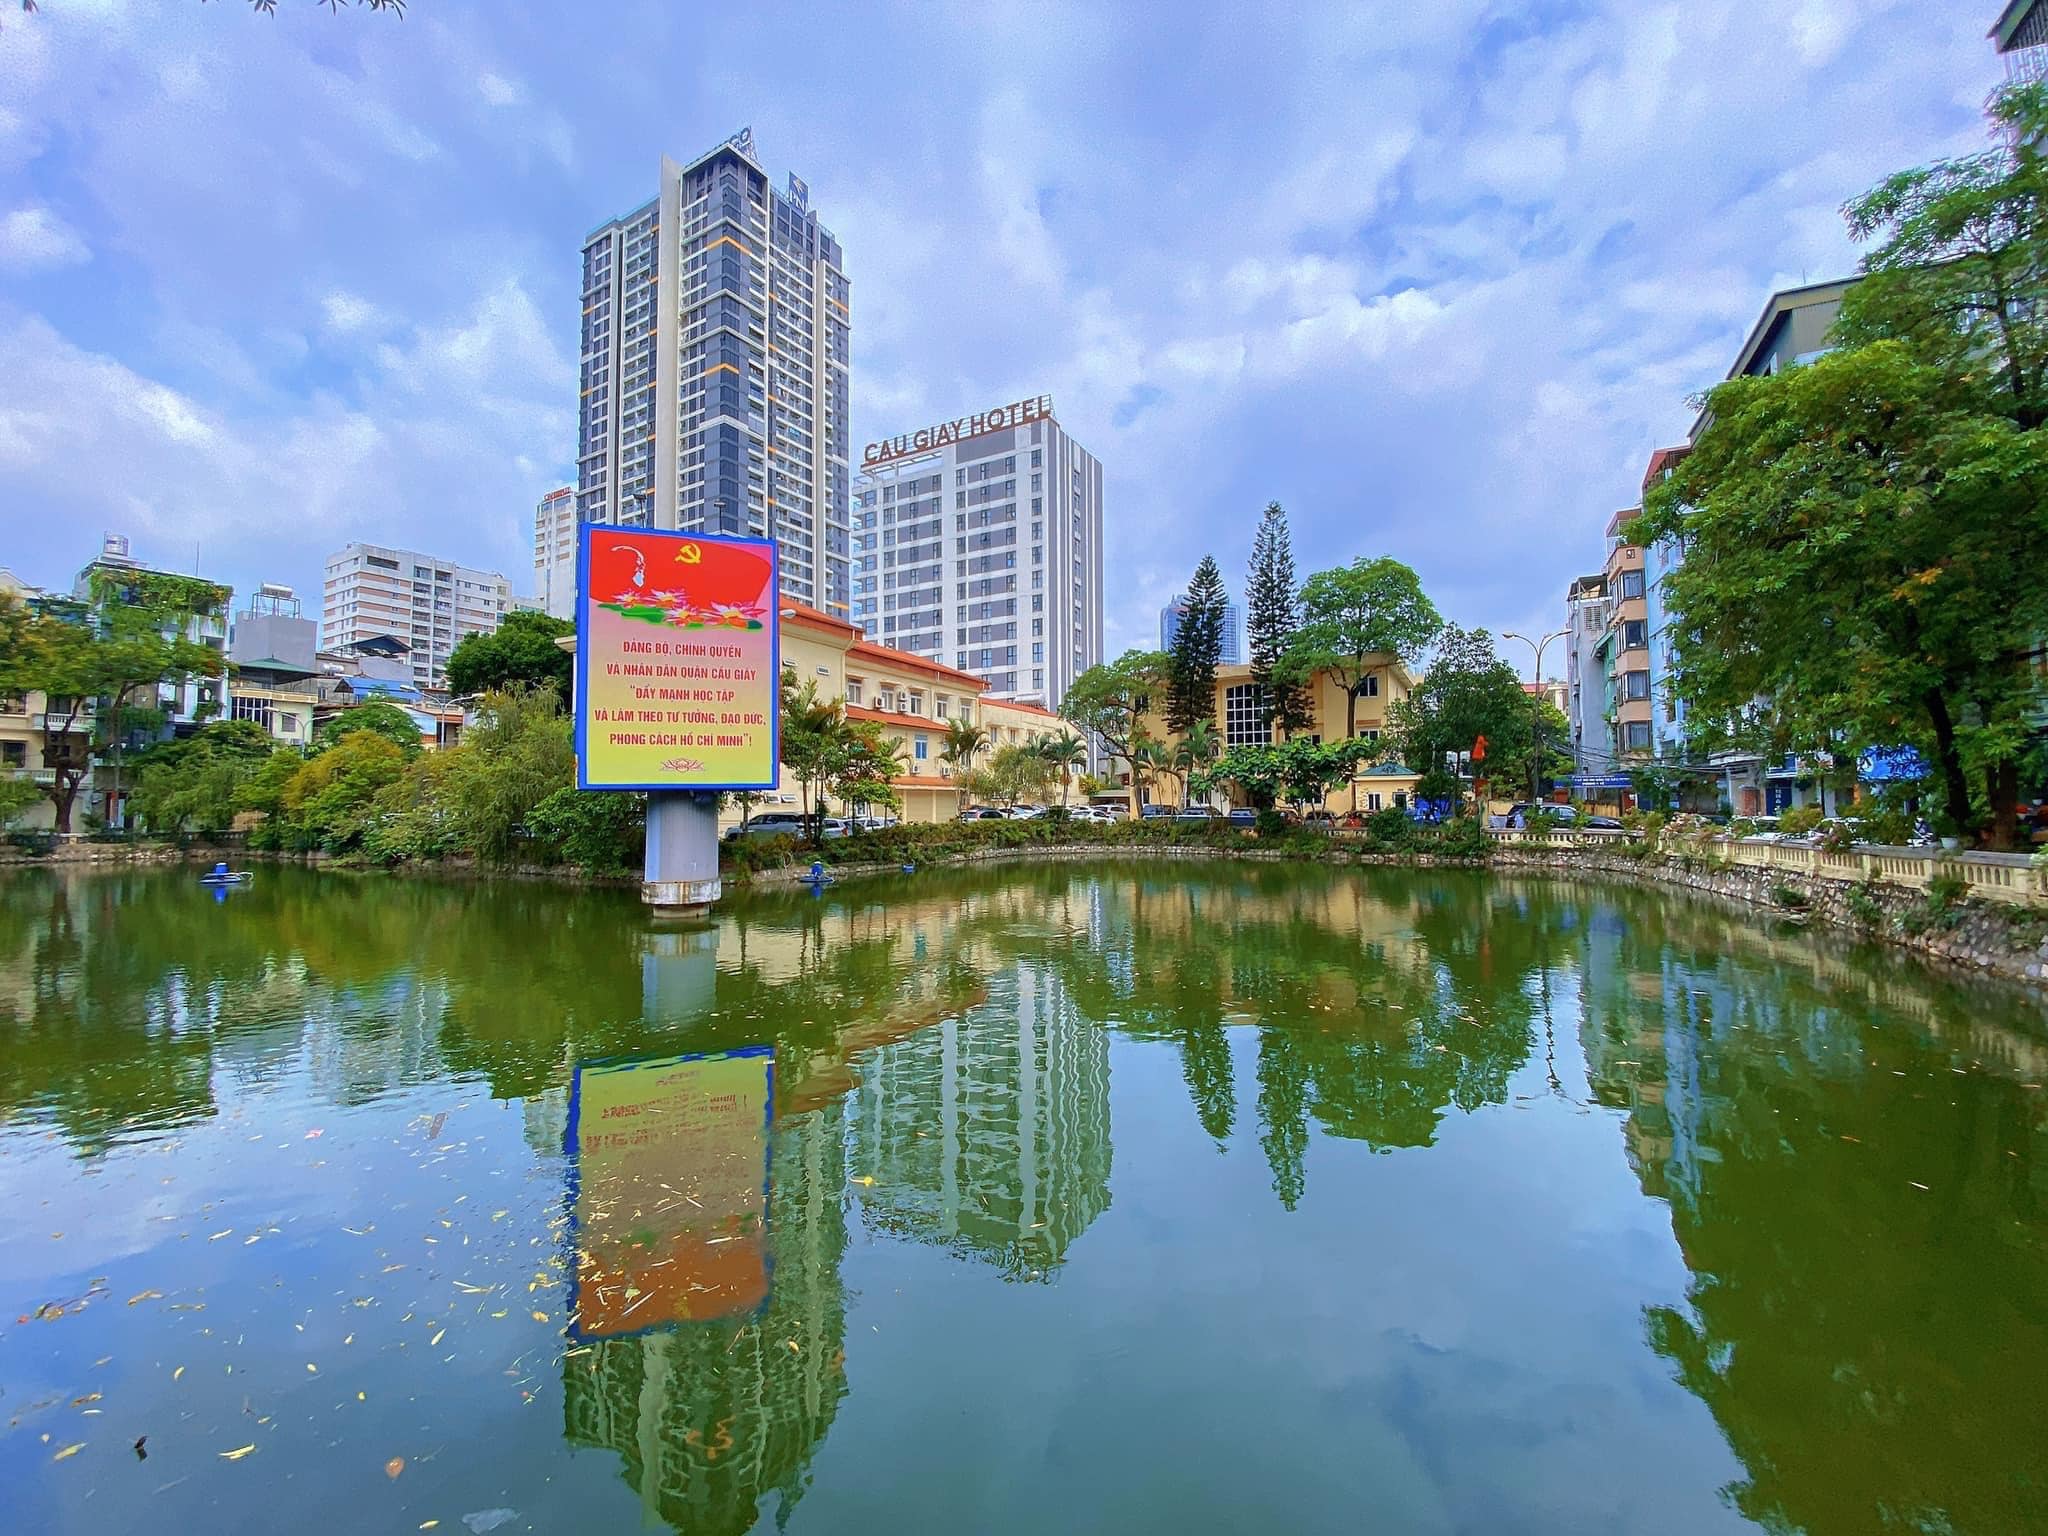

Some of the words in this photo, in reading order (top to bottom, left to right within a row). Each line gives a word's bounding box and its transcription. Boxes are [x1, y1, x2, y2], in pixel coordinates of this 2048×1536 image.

[789, 188, 808, 217] PNJ
[864, 433, 907, 464] CAU
[913, 418, 964, 450] GIAY
[970, 394, 1050, 437] HOTEL
[623, 638, 652, 653] ĐẢNG
[675, 642, 706, 656] CHÍNH
[607, 661, 620, 675] VÀ
[623, 662, 653, 677] NHÂN
[656, 663, 677, 677] DÂN
[680, 665, 708, 680] QUẬN
[711, 666, 731, 680] CẦU
[659, 688, 690, 702] MẠNH
[693, 690, 713, 704] HỌC
[716, 690, 735, 704] TẬP
[594, 708, 608, 722] VÀ
[611, 708, 634, 722] LÀM
[638, 710, 663, 723] THEO
[667, 711, 681, 723] TƯ
[721, 713, 741, 726] ĐẠO
[610, 733, 646, 745] PHONG
[649, 732, 677, 746] CÁCH
[680, 731, 694, 746] HỒ
[696, 733, 714, 746] CHÍ
